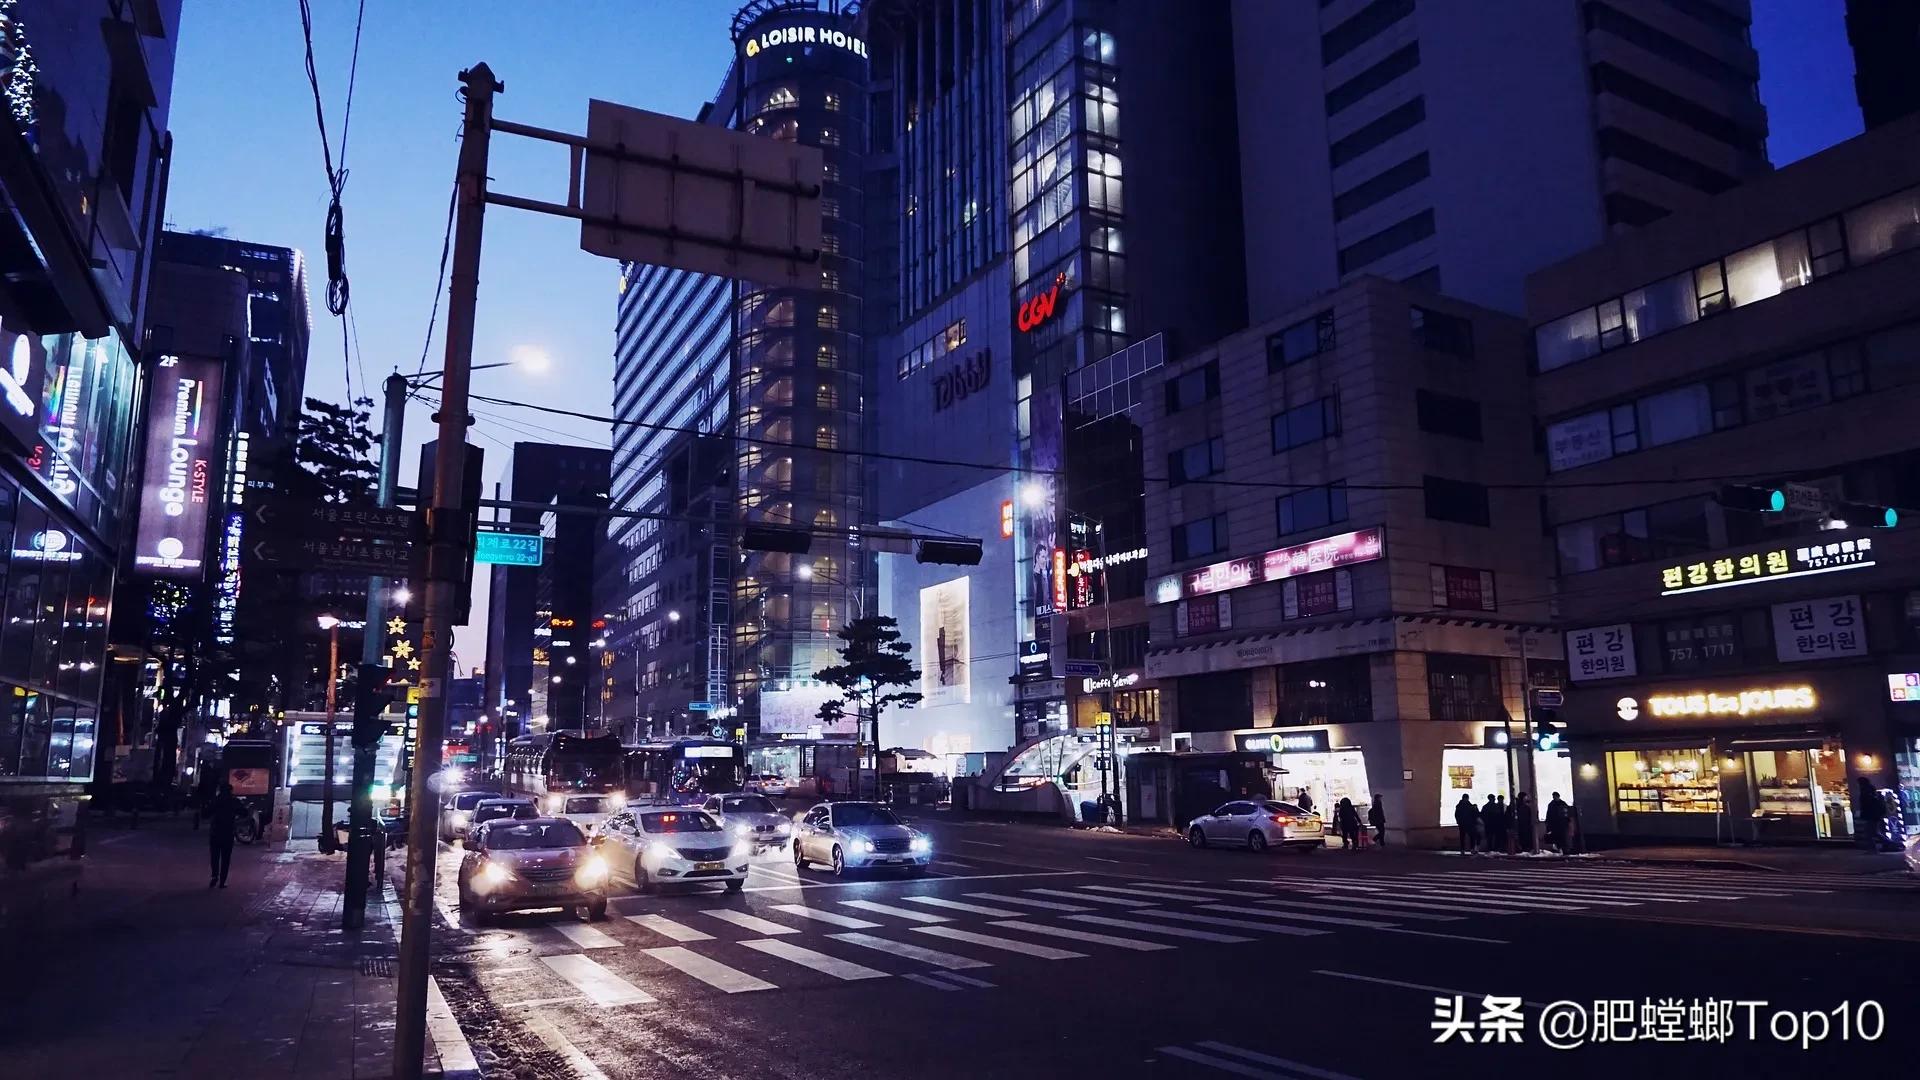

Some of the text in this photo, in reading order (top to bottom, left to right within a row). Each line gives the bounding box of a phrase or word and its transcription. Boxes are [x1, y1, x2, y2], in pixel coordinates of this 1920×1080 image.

[762, 26, 815, 49] LOISIR
[1017, 286, 1059, 331] CGV
[159, 355, 179, 368] 2F
[158, 378, 198, 517] Premium Lounge
[191, 459, 208, 504] K-STYLE
[1662, 549, 1790, 588] 편강한의원
[1807, 552, 1864, 568] 757-1717
[1796, 630, 1858, 655] 한의원
[1579, 655, 1626, 675] 한의원
[1649, 695, 1706, 716] TOUS
[1707, 693, 1739, 713] les
